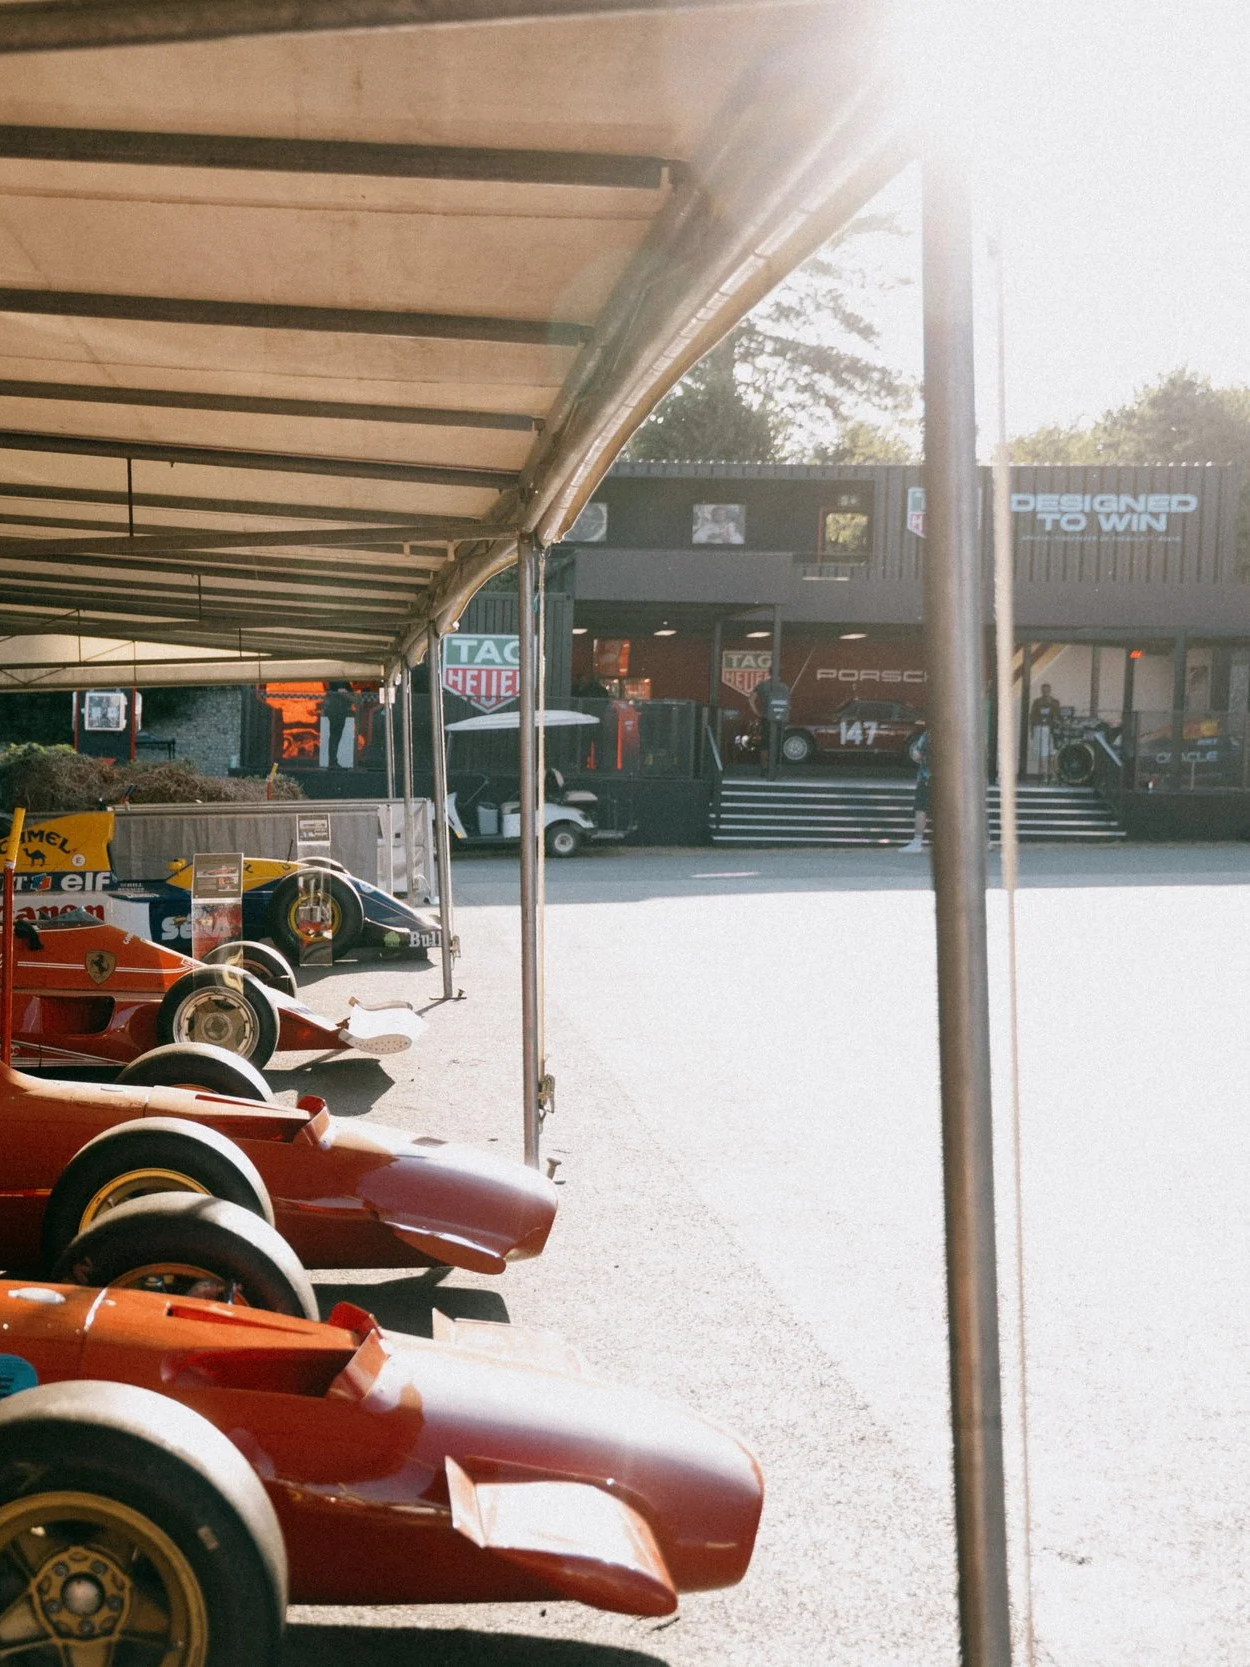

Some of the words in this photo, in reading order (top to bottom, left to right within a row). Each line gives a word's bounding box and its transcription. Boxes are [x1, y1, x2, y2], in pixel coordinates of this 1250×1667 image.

[1010, 493, 1198, 513] DESIGNED
[1037, 513, 1087, 532] TO
[1098, 513, 1167, 532] WIN
[816, 669, 926, 682] PORSC
[839, 722, 876, 745] 147
[60, 872, 111, 892] elf
